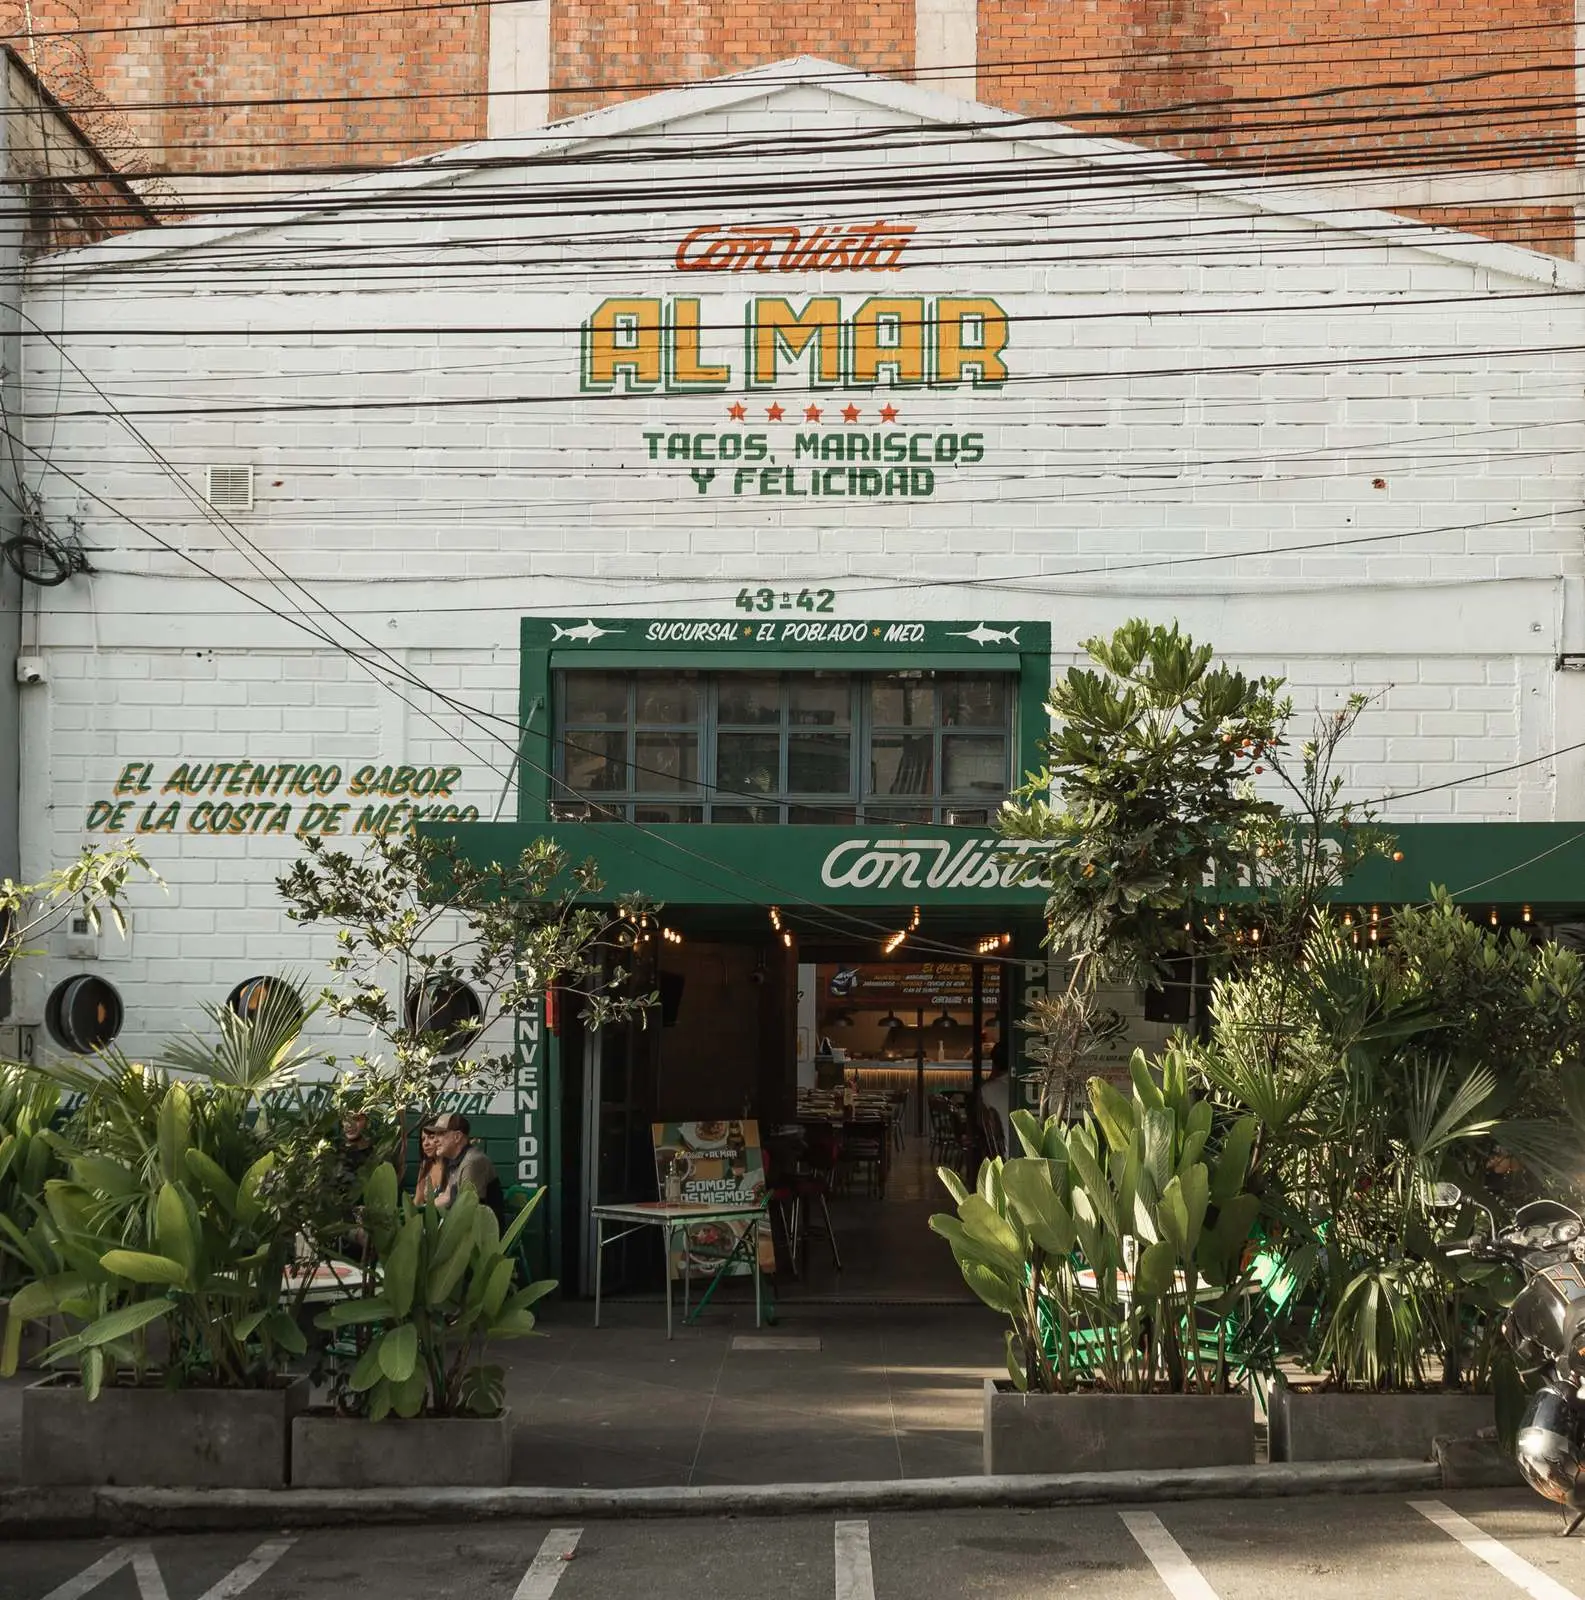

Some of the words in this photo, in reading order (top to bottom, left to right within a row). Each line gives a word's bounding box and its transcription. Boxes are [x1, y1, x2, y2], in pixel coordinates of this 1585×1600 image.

[642, 432, 775, 464] TACOS,
[795, 432, 984, 463] MARISCOS
[689, 467, 715, 494] Y
[733, 466, 935, 496] FELICIDAD
[645, 622, 738, 642] SUCURSAL
[756, 623, 776, 642] EL
[781, 623, 868, 642] POBLADO
[883, 624, 925, 643] MED.
[112, 761, 154, 797] EL
[160, 758, 343, 798] AUTÉNTICO
[346, 765, 462, 799] SABOR
[85, 800, 135, 835] DE
[135, 801, 178, 835] LA
[185, 801, 292, 836] COSTA
[295, 802, 352, 837] DE
[680, 1192, 699, 1204] OS
[701, 1190, 756, 1203] MISMOS
[685, 1179, 736, 1193] SOMOS
